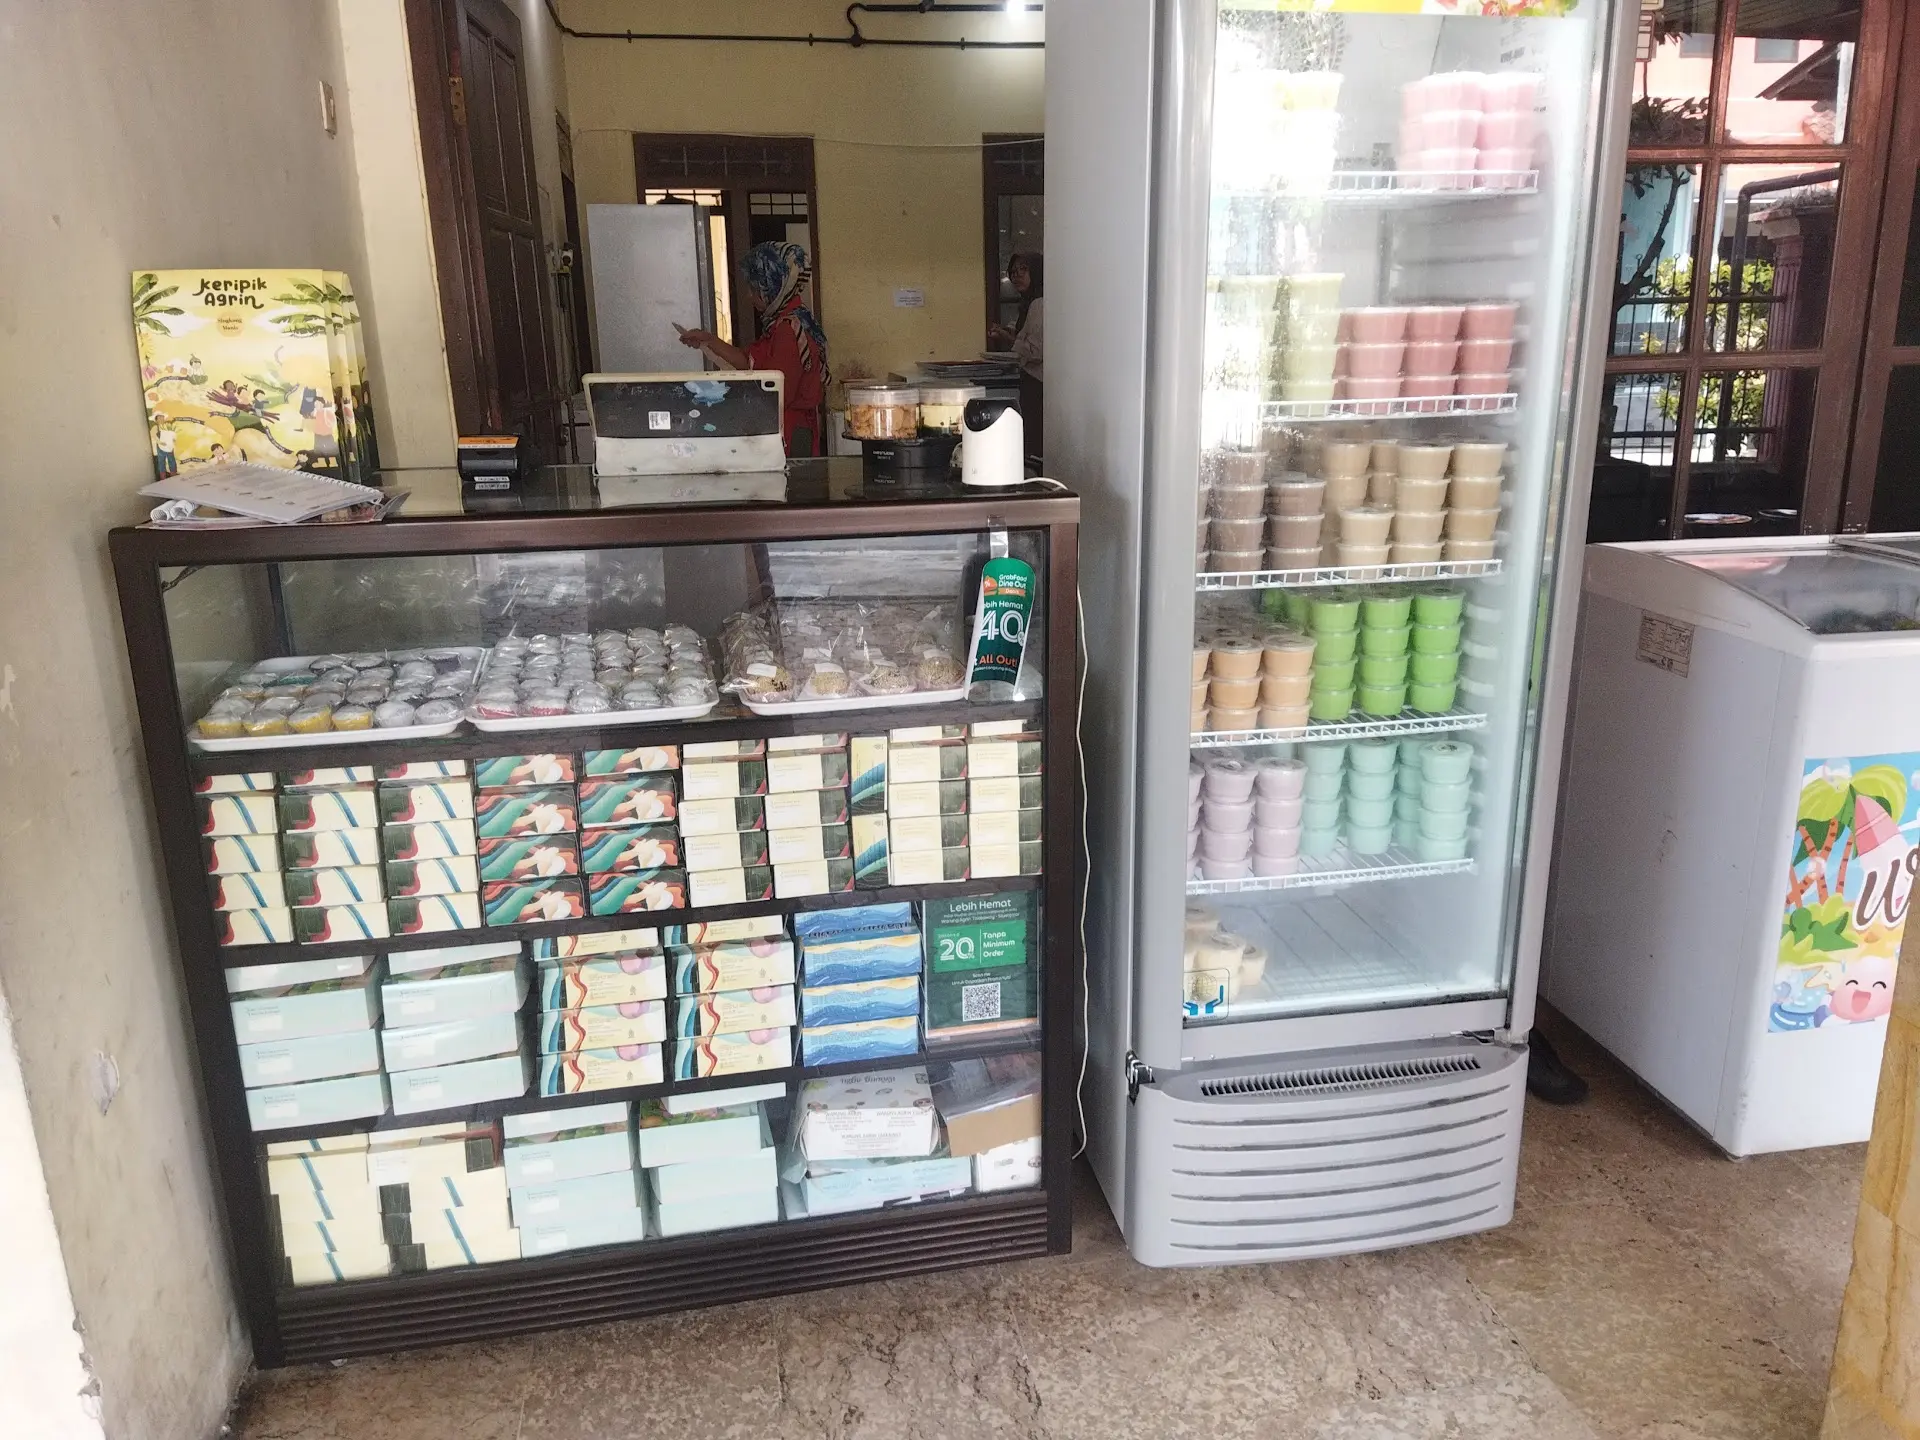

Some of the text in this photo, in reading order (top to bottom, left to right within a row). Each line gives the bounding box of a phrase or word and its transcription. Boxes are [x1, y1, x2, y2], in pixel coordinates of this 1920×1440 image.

[204, 292, 264, 309] Agrin
[998, 574, 1028, 582] GrabFood
[1014, 580, 1027, 589] Out
[998, 600, 1024, 610] Hemat
[979, 654, 994, 665] All
[949, 901, 977, 913] Lebih
[979, 899, 1012, 910] Hemat
[982, 931, 1007, 939] Tanpa
[982, 940, 1016, 948] Minimum
[983, 949, 1004, 958] Order
